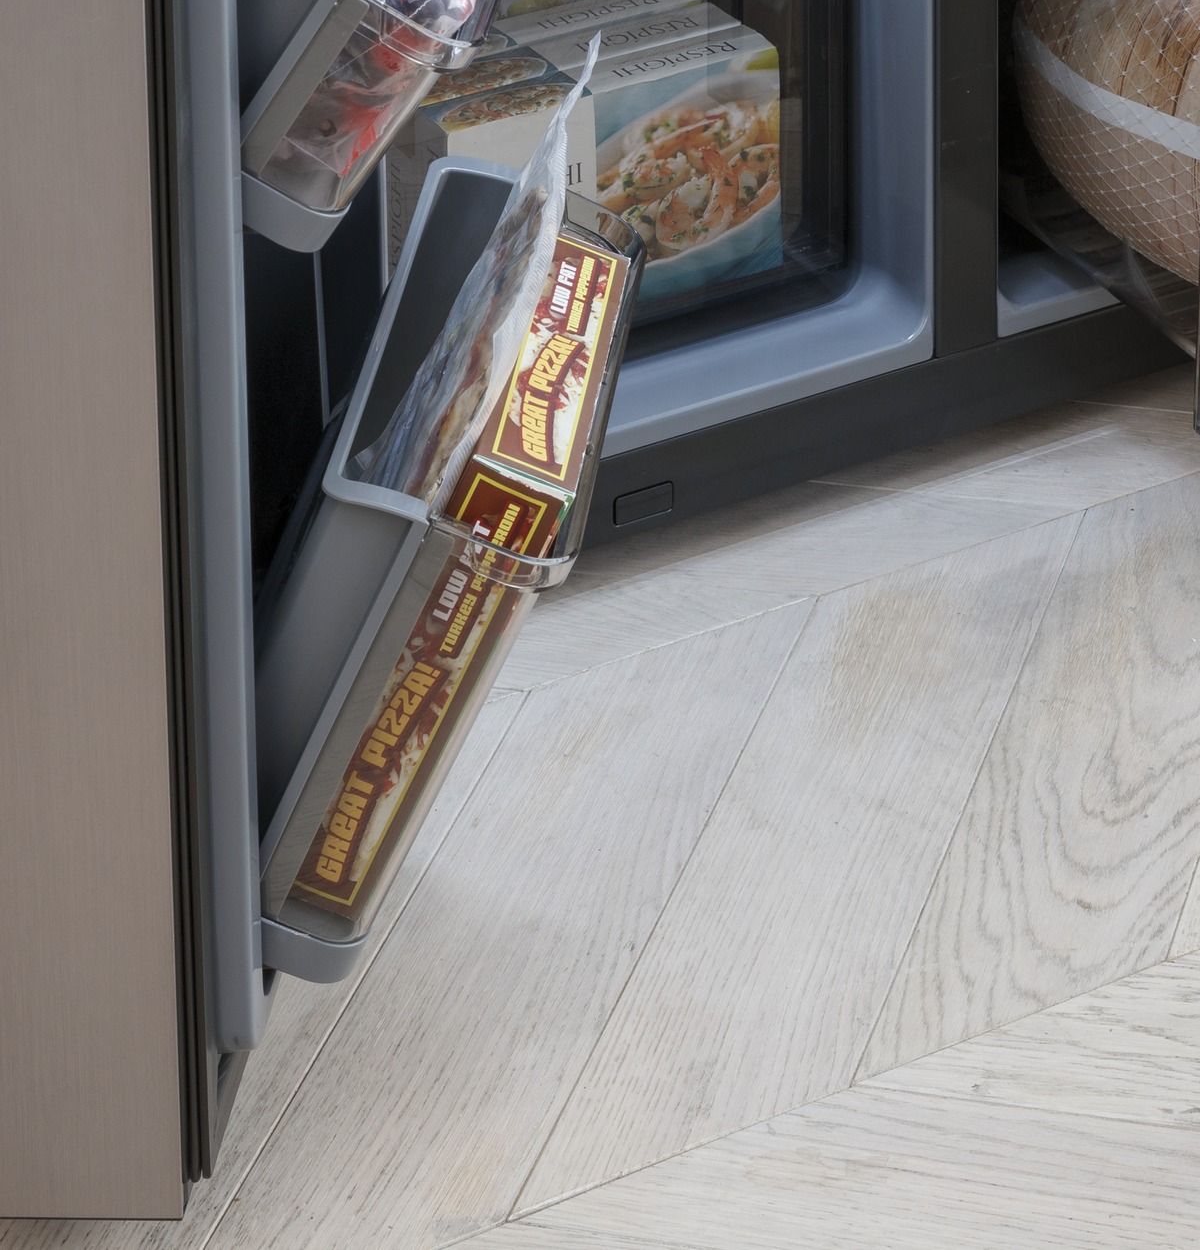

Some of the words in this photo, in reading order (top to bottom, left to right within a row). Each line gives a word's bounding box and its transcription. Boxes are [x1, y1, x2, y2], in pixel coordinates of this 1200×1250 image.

[550, 284, 571, 314] LOW
[557, 261, 577, 287] FAT
[566, 302, 585, 333] TURKEY
[528, 334, 580, 393] PIZZA!
[521, 391, 549, 462] GREAT
[432, 569, 469, 622] LOW
[315, 771, 374, 883] GREAT
[360, 661, 443, 768] PIZZA!
